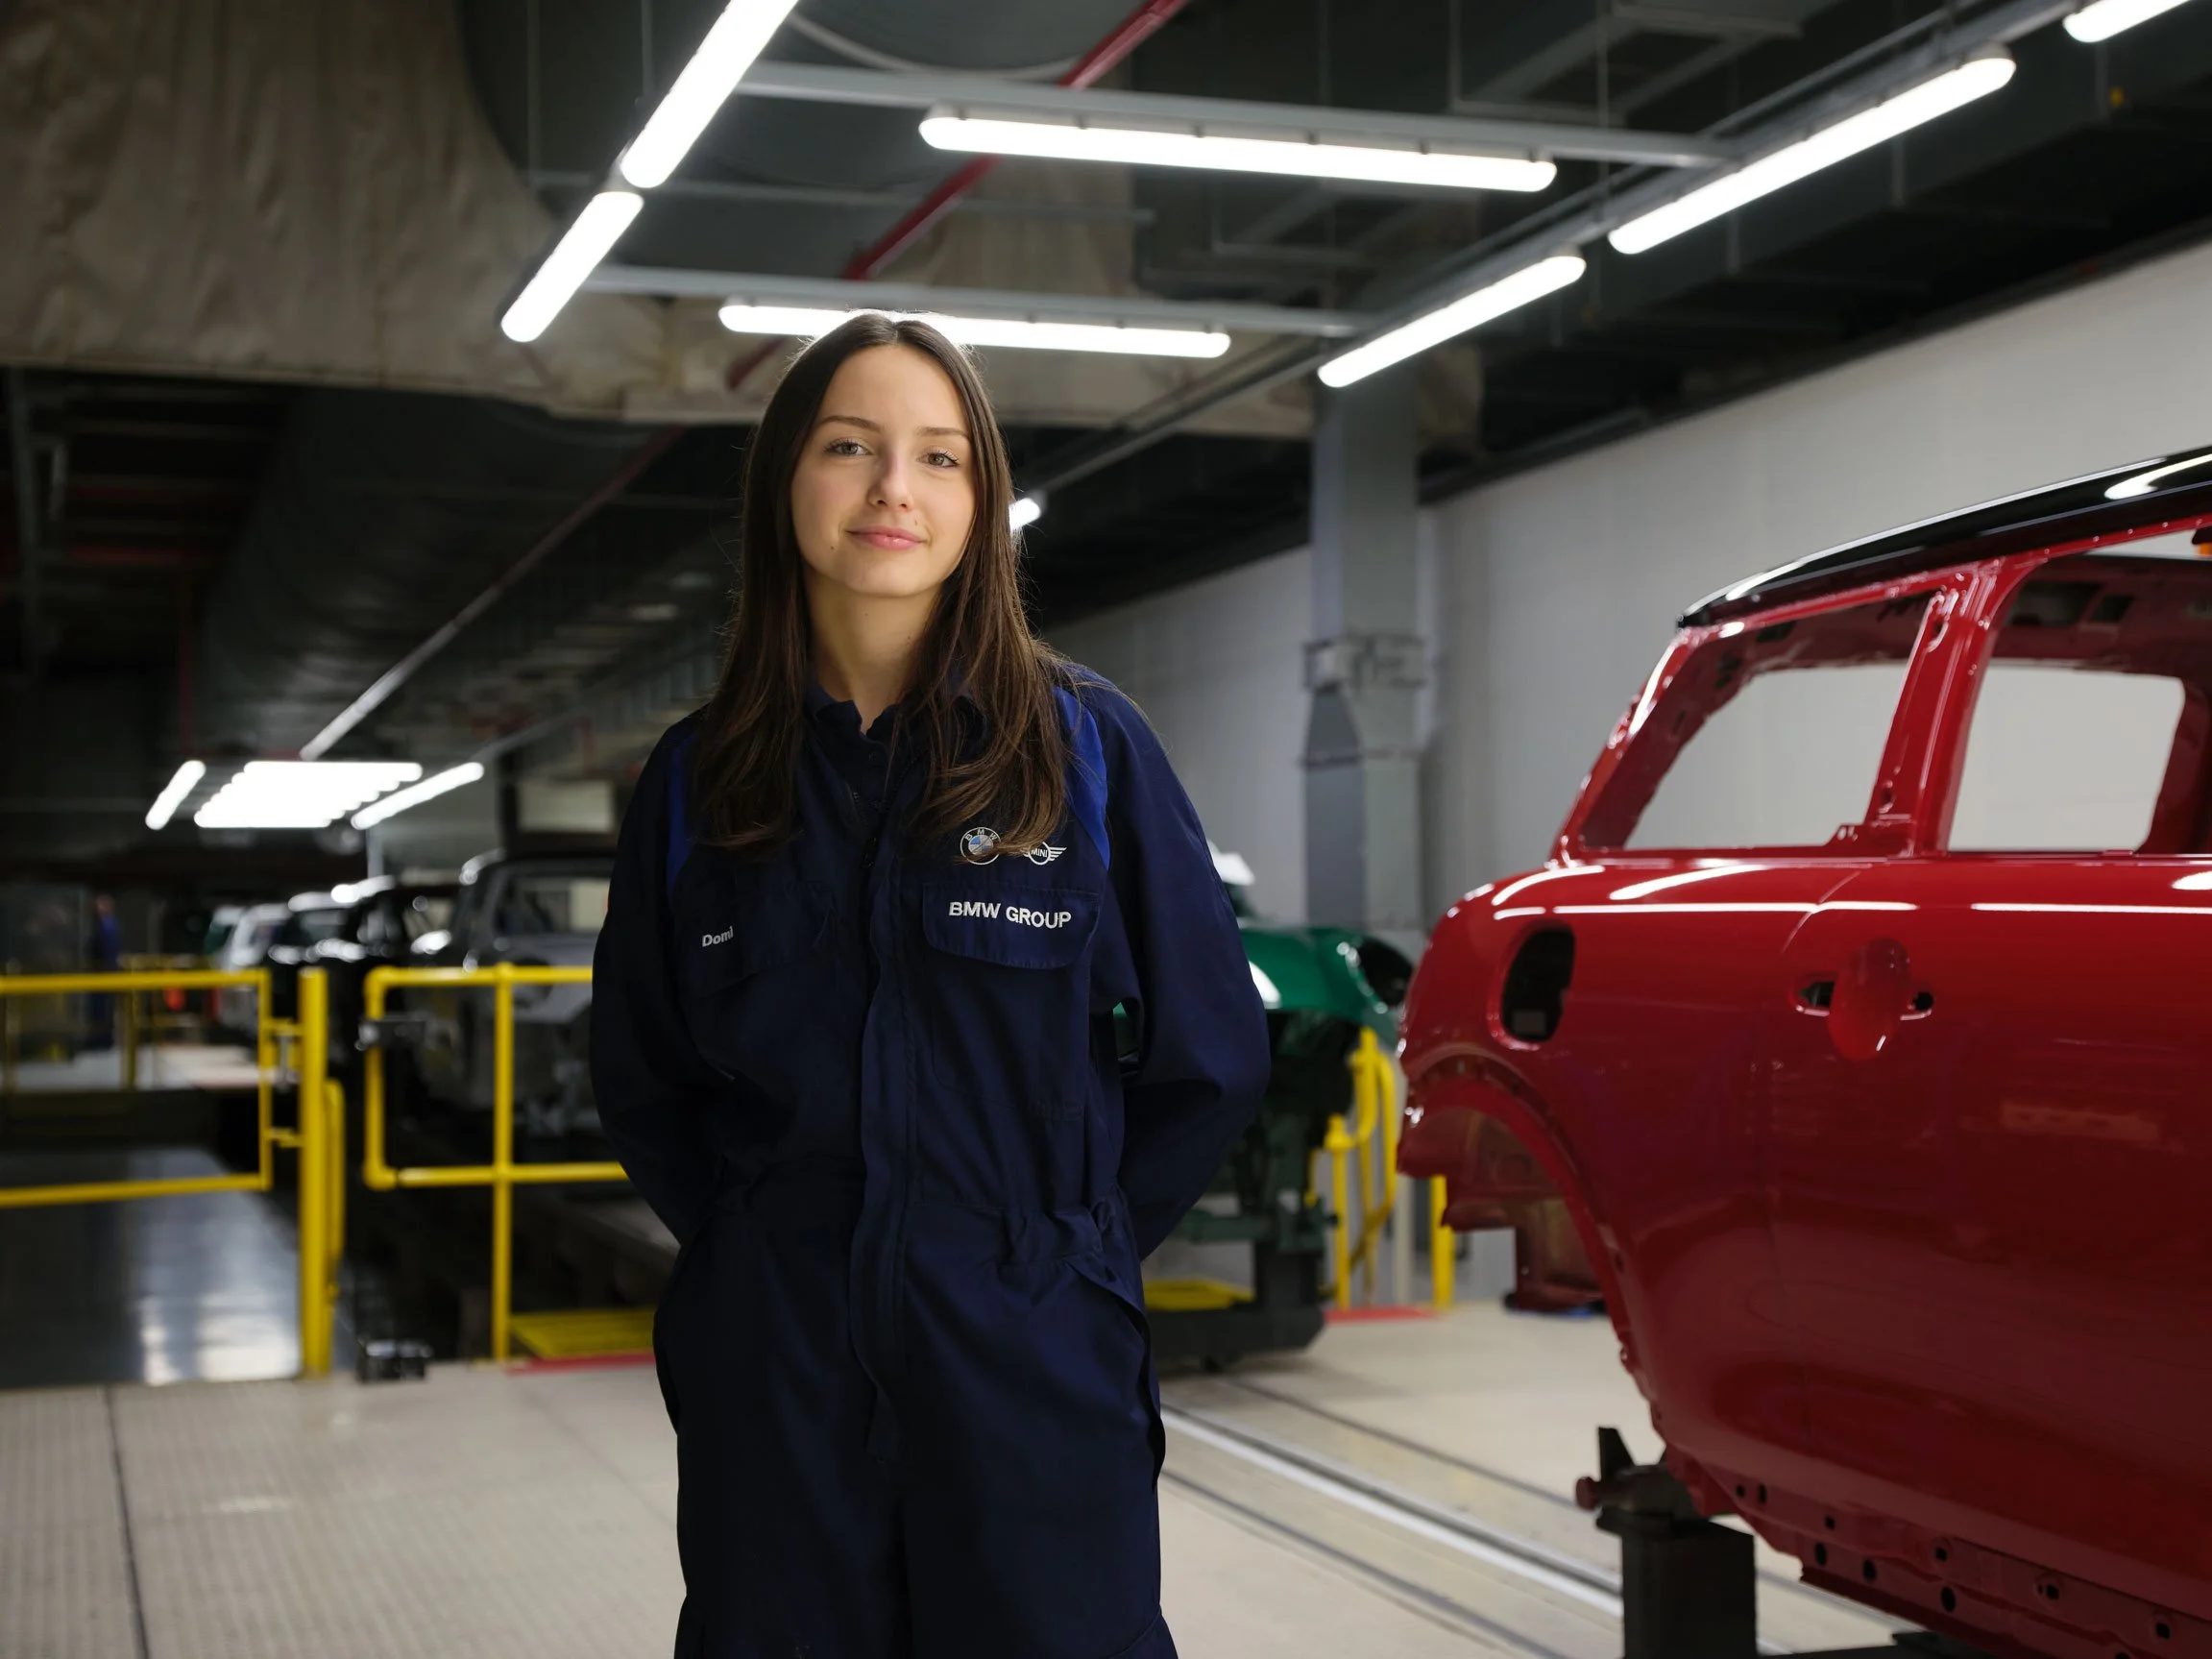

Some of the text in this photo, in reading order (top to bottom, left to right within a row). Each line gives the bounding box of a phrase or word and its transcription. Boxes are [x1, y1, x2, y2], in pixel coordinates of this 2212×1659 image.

[964, 828, 999, 842] BMW
[1031, 847, 1048, 858] MINI
[949, 901, 1072, 929] BMW GROUP
